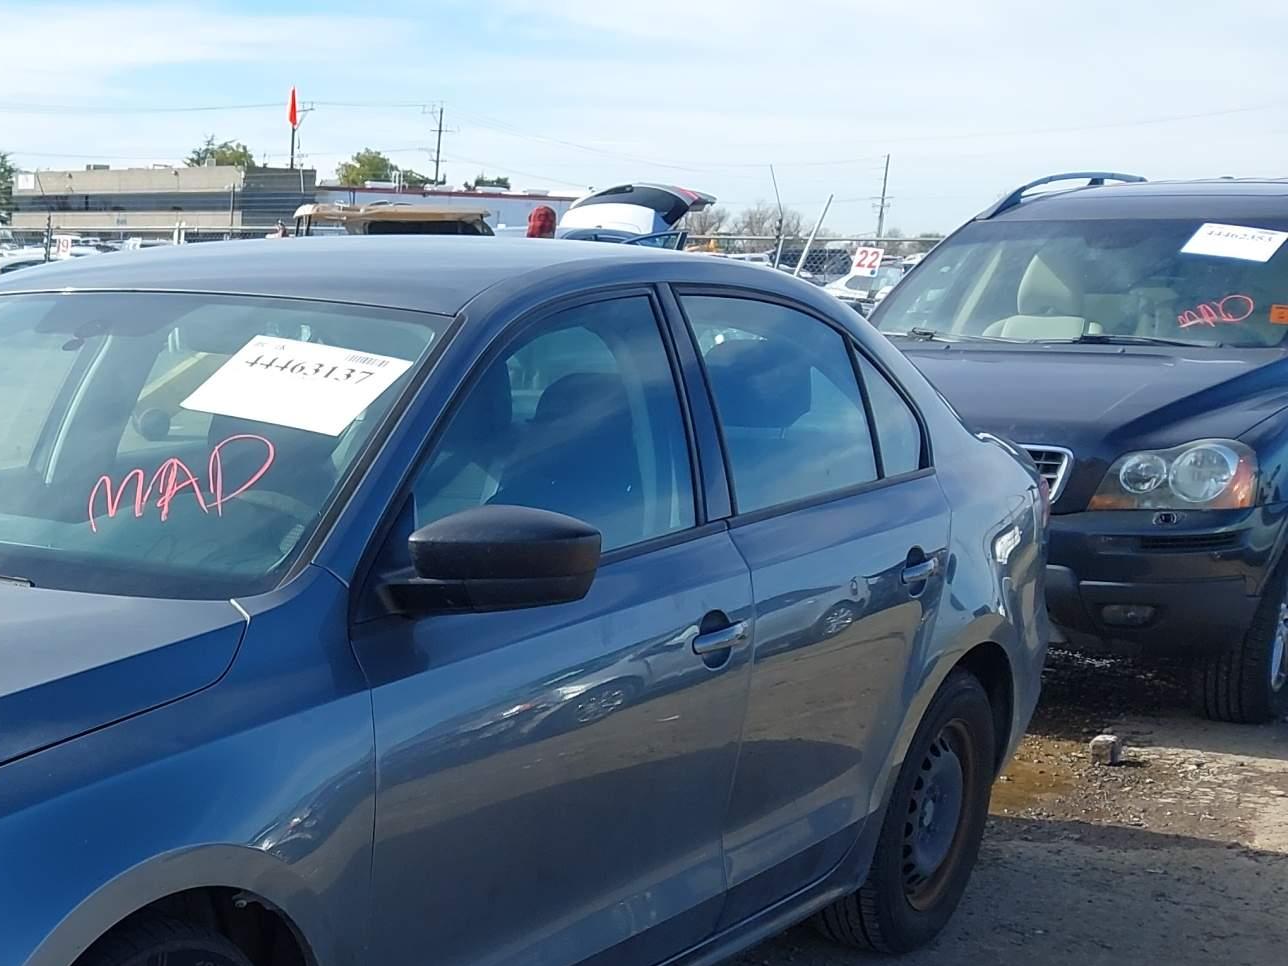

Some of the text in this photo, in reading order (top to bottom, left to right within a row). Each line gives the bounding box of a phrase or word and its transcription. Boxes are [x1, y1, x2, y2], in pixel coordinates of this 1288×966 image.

[855, 249, 880, 269] 22
[244, 353, 375, 386] 44463137
[88, 433, 276, 534] MAD
